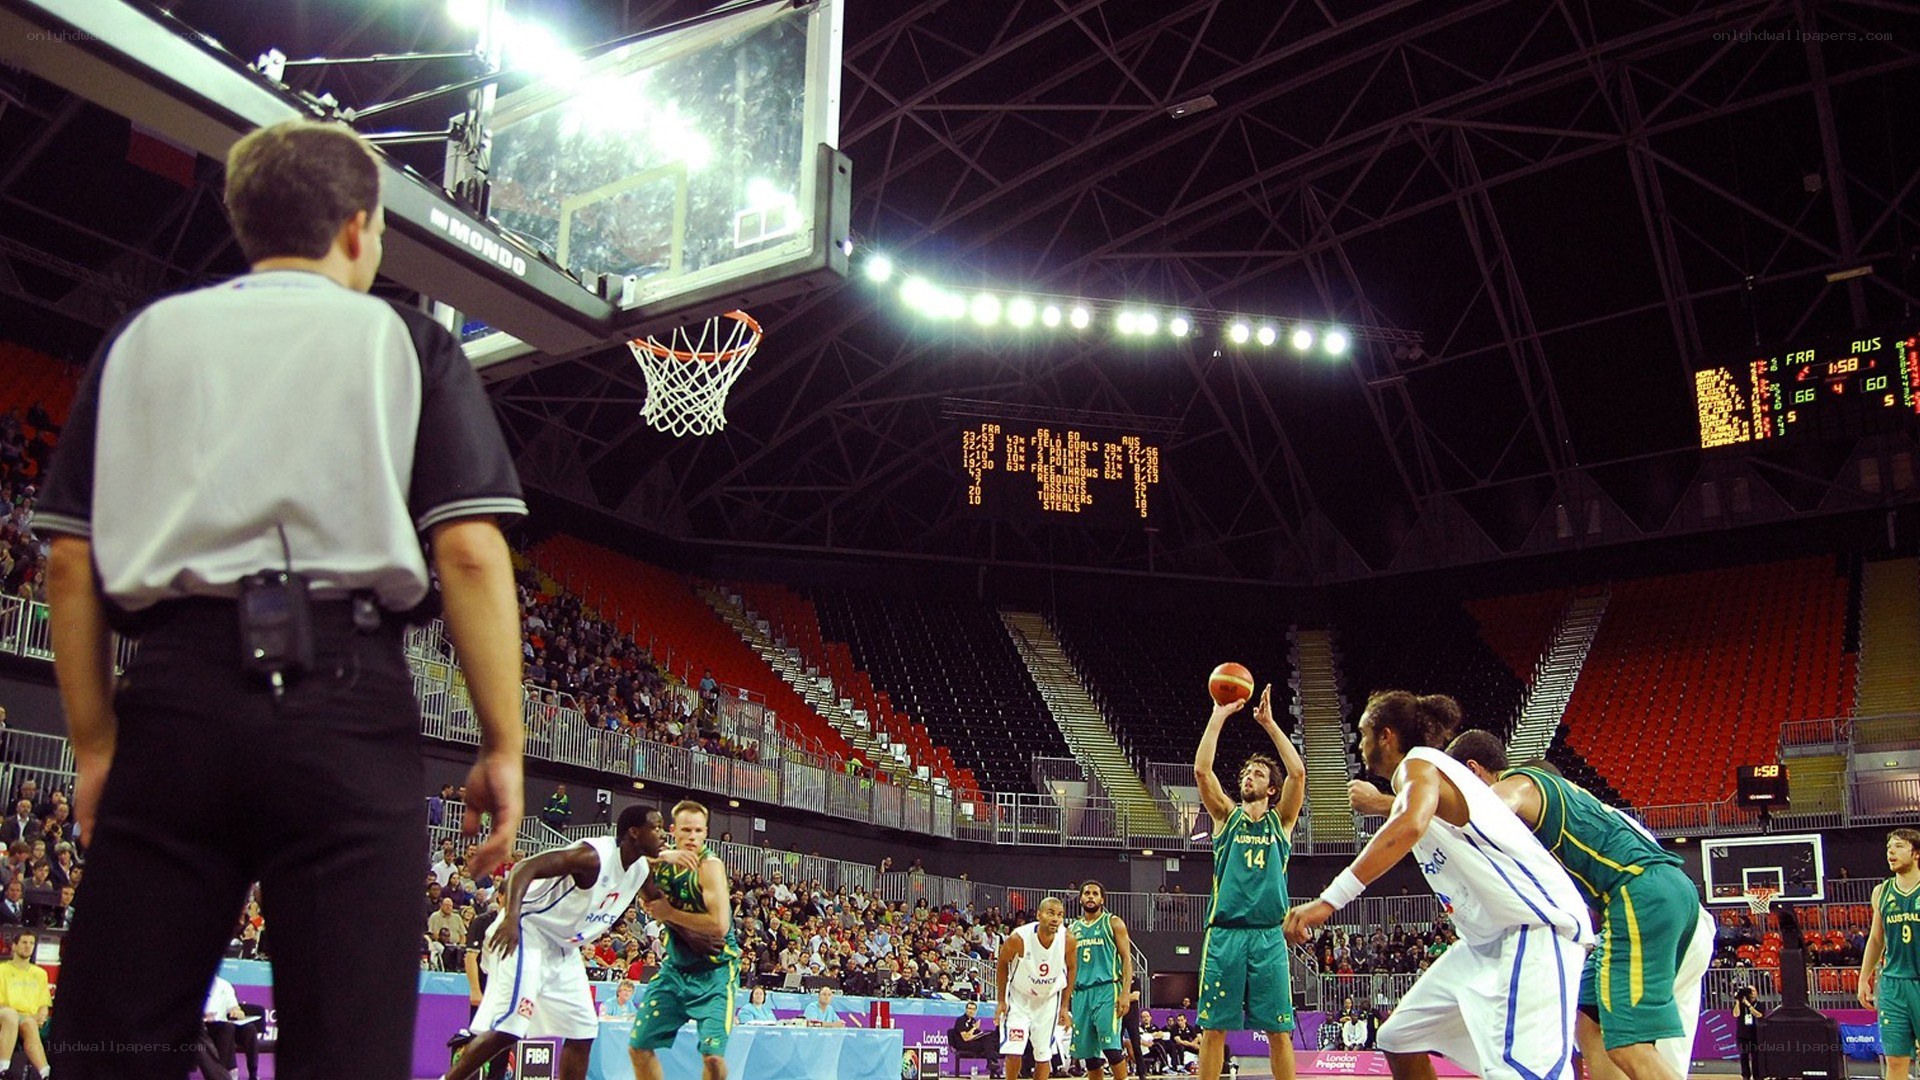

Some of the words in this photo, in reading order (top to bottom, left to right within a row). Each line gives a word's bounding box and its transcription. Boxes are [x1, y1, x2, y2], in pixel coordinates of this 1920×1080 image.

[448, 217, 527, 277] MONDO
[1851, 337, 1881, 354] AUS
[1786, 350, 1815, 366] FRA
[1829, 358, 1858, 374] 1:58
[1866, 375, 1887, 391] 60
[1795, 388, 1815, 403] 66
[982, 423, 1000, 434] FRA
[1037, 428, 1050, 438] 66
[1067, 431, 1080, 441] 60
[963, 431, 994, 442] 23/53
[1006, 434, 1025, 444] 43%
[1031, 436, 1062, 448] FIELD
[1067, 440, 1099, 452] GOALS
[1104, 443, 1123, 453] 39%
[1122, 435, 1140, 446] AUS
[963, 440, 995, 452] 22/43
[1006, 443, 1025, 453] 51%
[1037, 446, 1044, 455] 2
[1049, 447, 1087, 459] POINTS
[1104, 452, 1123, 462] 47%
[1128, 446, 1158, 457] 22/56
[963, 450, 988, 460] 1/10
[1007, 453, 1025, 462] 10%
[1049, 456, 1087, 468] POINTS
[1104, 461, 1123, 470] 31%
[1129, 455, 1158, 465] 14/30
[963, 459, 994, 470] 19/30
[1006, 461, 1025, 471] 63%
[1031, 463, 1056, 475] FREE
[1062, 466, 1099, 479] THROWS
[1104, 470, 1123, 480] 62%
[968, 467, 981, 477] 43
[1037, 473, 1087, 486] REBOUNDS
[1134, 481, 1147, 491] 25
[968, 485, 981, 496] 20
[1037, 491, 1093, 505] TURNOVERS
[1135, 499, 1147, 509] 18
[1043, 483, 1087, 495] ASSISTS
[1135, 490, 1147, 500] 14
[968, 495, 981, 505] 10
[1043, 501, 1081, 513] STEALS
[1753, 765, 1779, 778] 1:58
[1233, 834, 1278, 845] AUSTRALA
[1244, 848, 1266, 869] 14
[1902, 924, 1912, 944] 9
[1082, 947, 1091, 962] 5
[1039, 963, 1049, 977] 9
[923, 1030, 949, 1045] London
[525, 1047, 550, 1065] FIBA
[1326, 1053, 1358, 1062] London
[1316, 1060, 1356, 1070] Prepares
